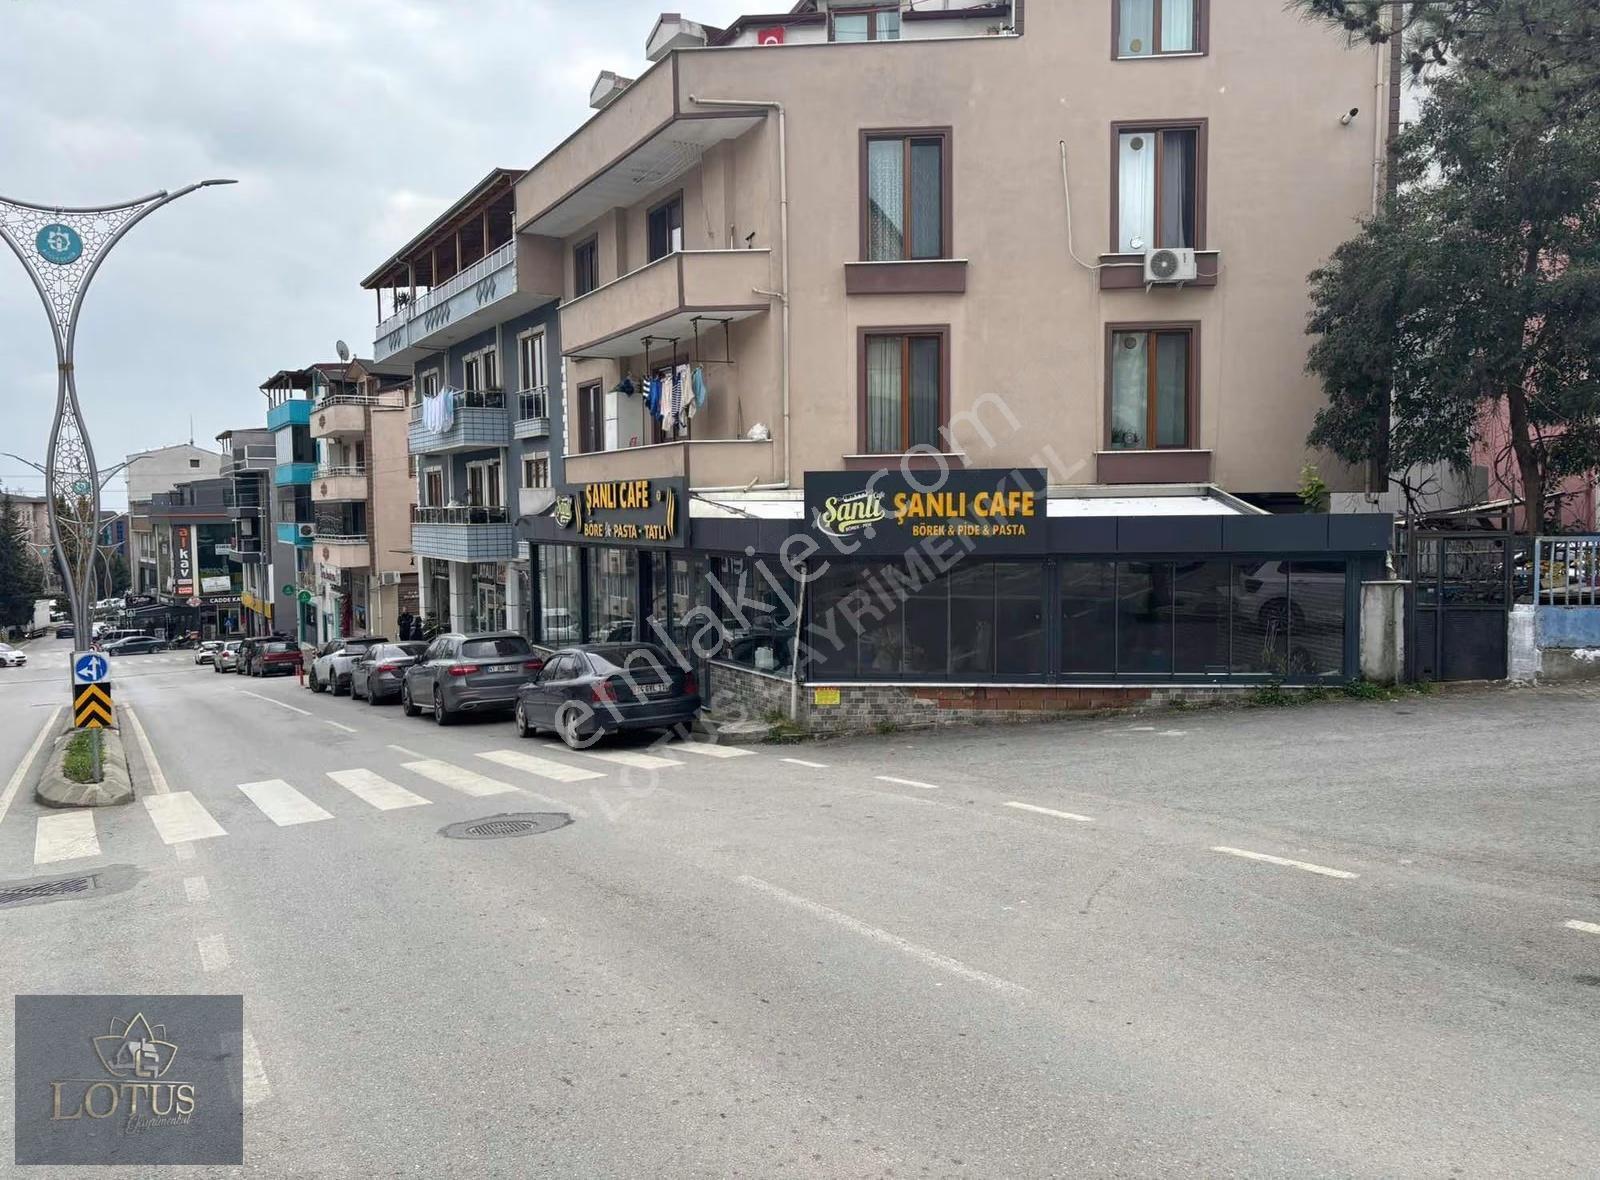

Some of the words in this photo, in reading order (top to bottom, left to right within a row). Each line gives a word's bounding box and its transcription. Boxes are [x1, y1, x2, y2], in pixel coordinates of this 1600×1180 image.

[585, 483, 617, 516] ŞANLI
[619, 480, 649, 508] CAFE
[894, 492, 966, 524] ŞANLI
[973, 491, 1035, 517] CAFE
[613, 524, 637, 538] PASTA
[644, 524, 666, 540] TATLI
[912, 522, 945, 536] BÖREK
[957, 521, 980, 536] PİDE
[992, 524, 1026, 536] PASTA
